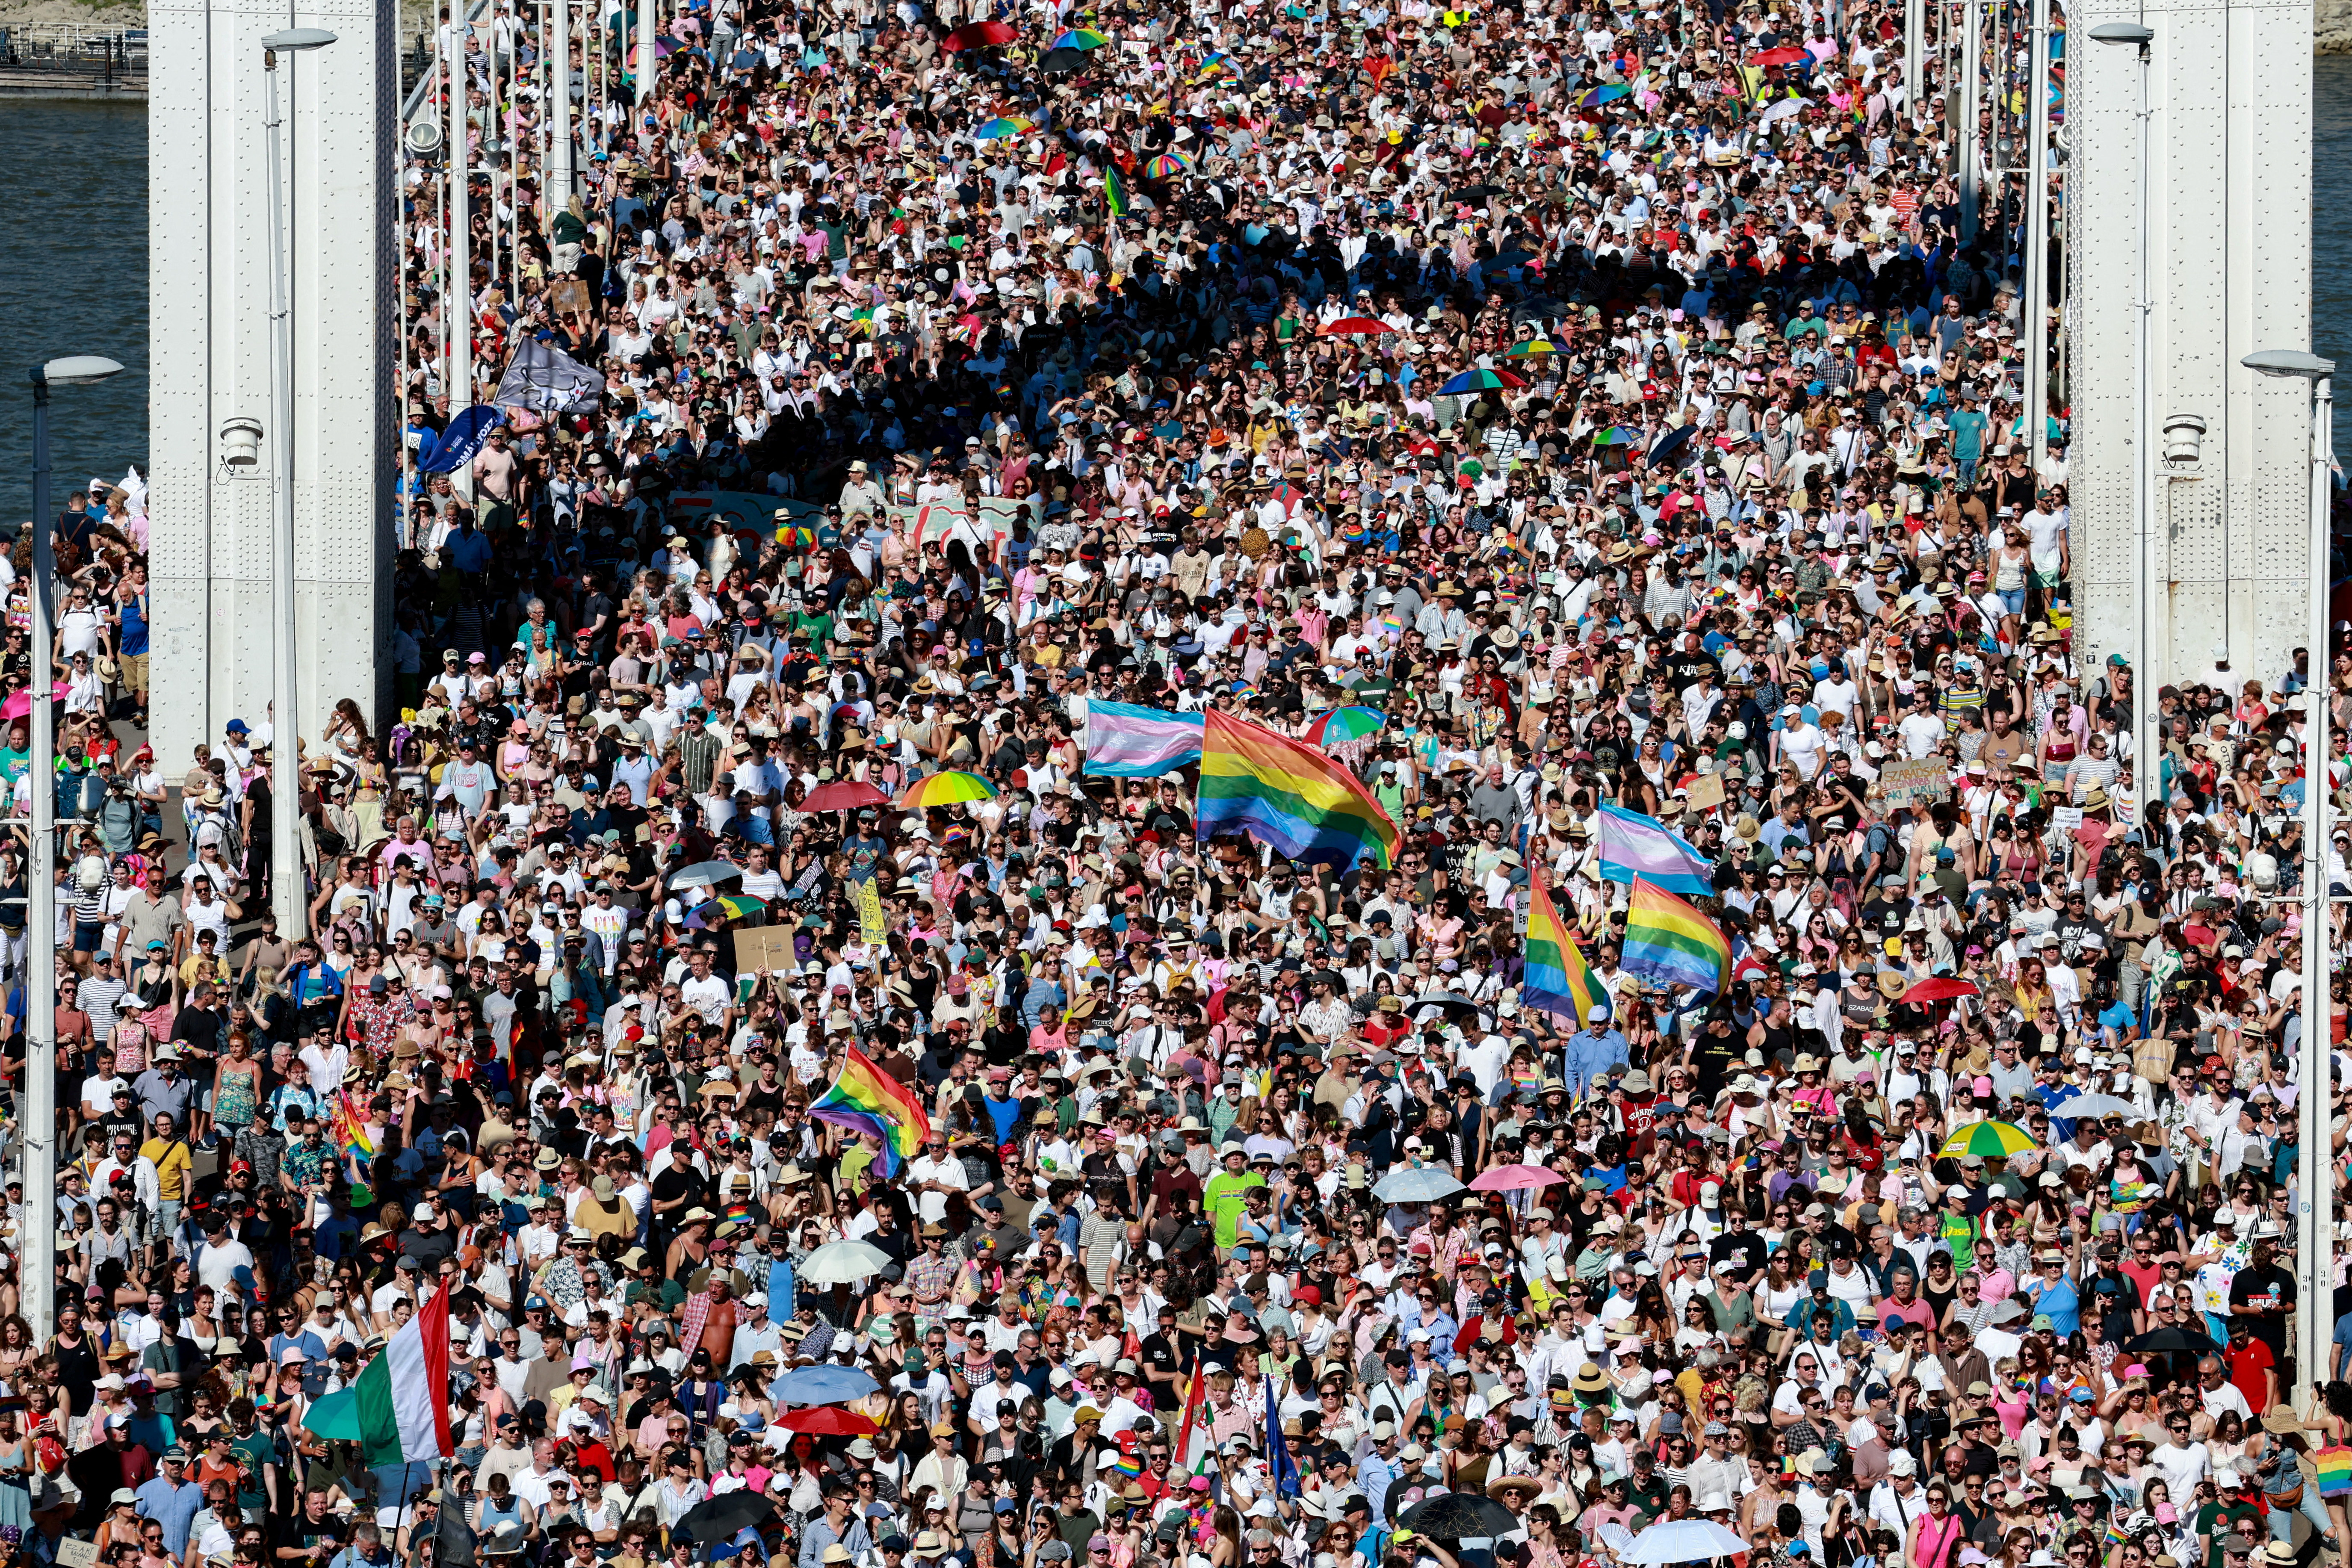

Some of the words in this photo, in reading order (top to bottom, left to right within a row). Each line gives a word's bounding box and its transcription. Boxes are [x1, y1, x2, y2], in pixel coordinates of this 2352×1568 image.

[1916, 83, 1920, 93] 34
[2025, 431, 2029, 443] 32
[2039, 429, 2042, 441] 32
[1909, 760, 1921, 769] A
[1884, 763, 1946, 782] SZABADSÁG
[2136, 778, 2139, 792] 31
[2150, 776, 2154, 790] 31
[536, 939, 555, 948] LOV
[1628, 1108, 1656, 1121] STANFO
[1952, 1227, 1971, 1235] asics
[2303, 1275, 2308, 1292] 30
[2321, 1270, 2325, 1287] 30
